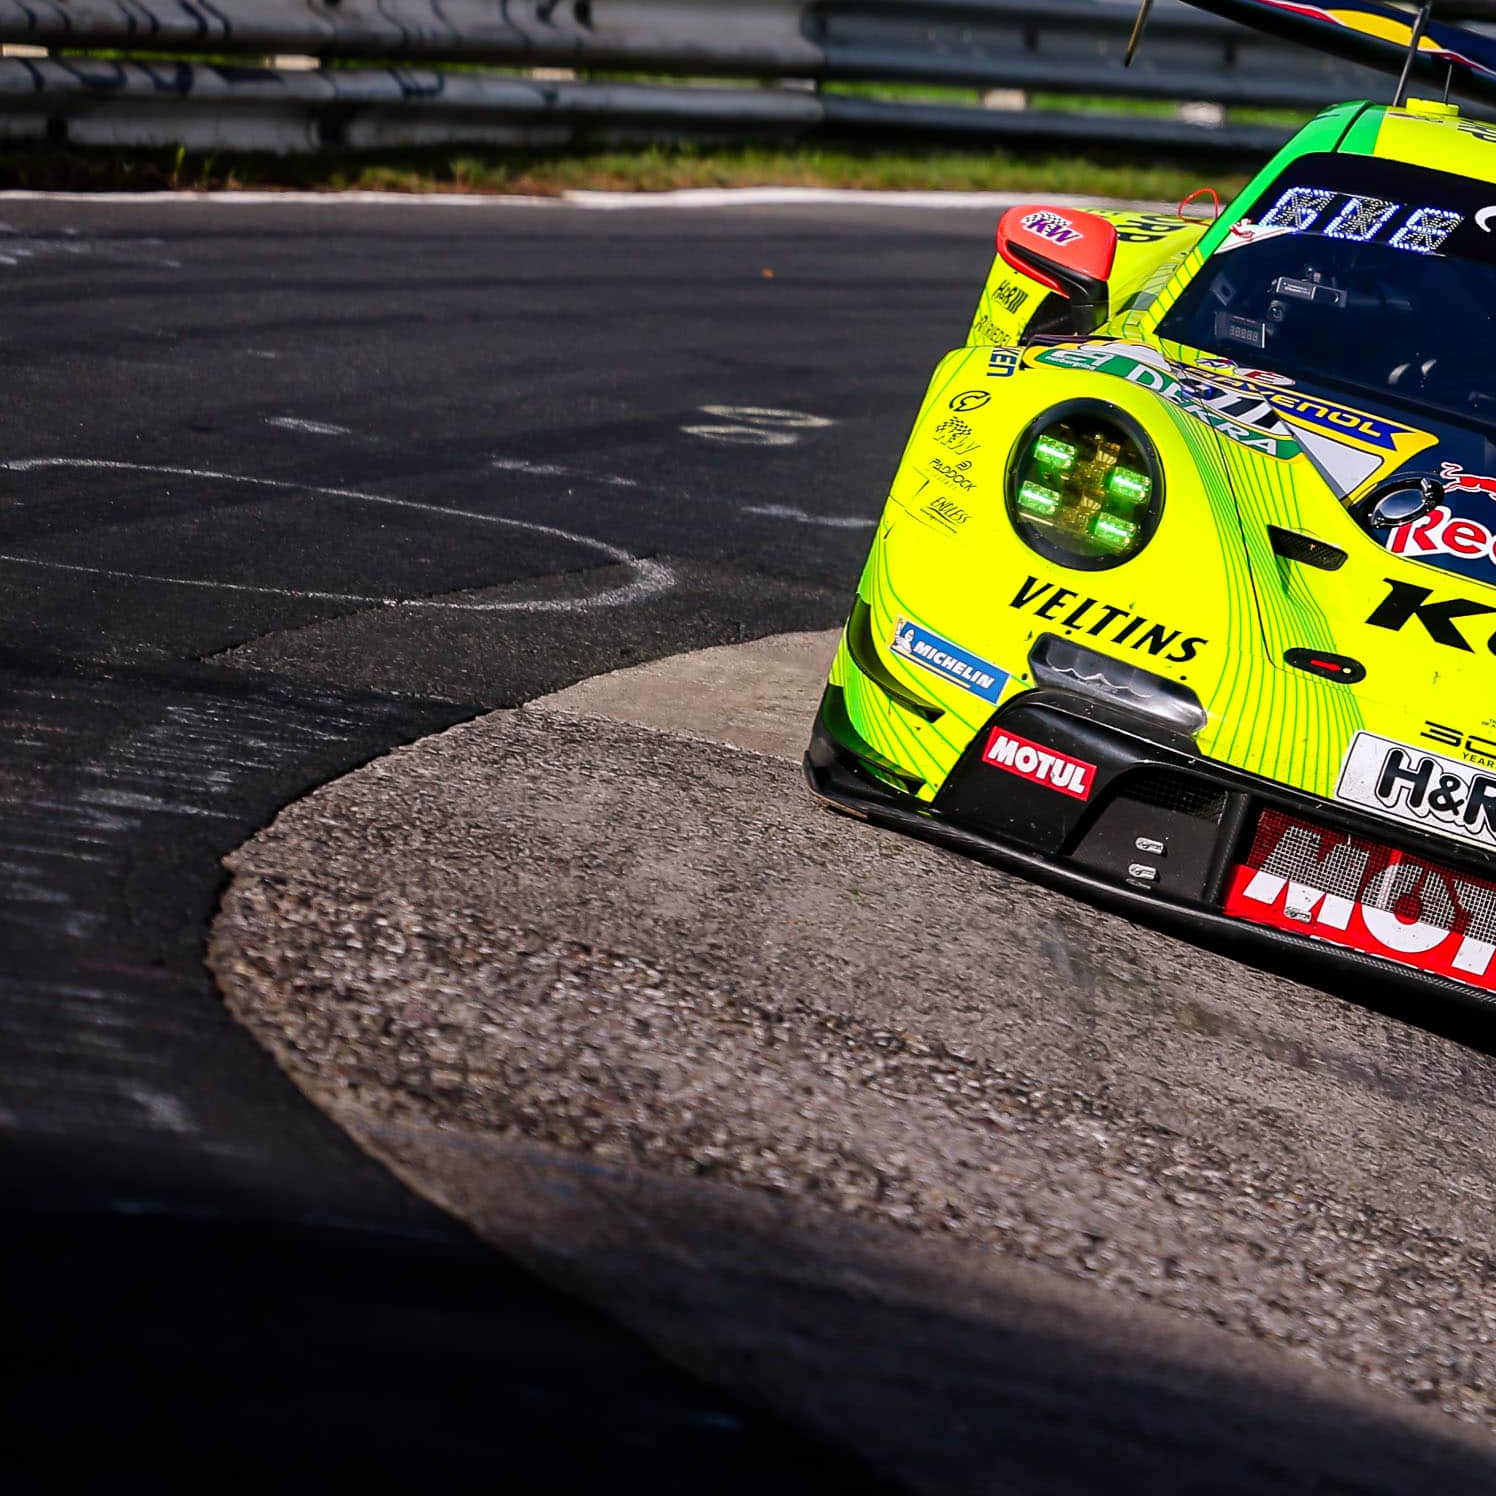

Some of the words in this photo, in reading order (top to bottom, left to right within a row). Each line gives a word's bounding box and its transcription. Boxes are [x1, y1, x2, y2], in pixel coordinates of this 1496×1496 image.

[1125, 366, 1276, 455] DEKRA
[1184, 366, 1381, 438] RAVENOL
[928, 458, 977, 492] PADDOCK
[1008, 575, 1209, 664] VELTINS
[914, 640, 995, 690] MICHELIN
[988, 735, 1087, 794] MOTUL
